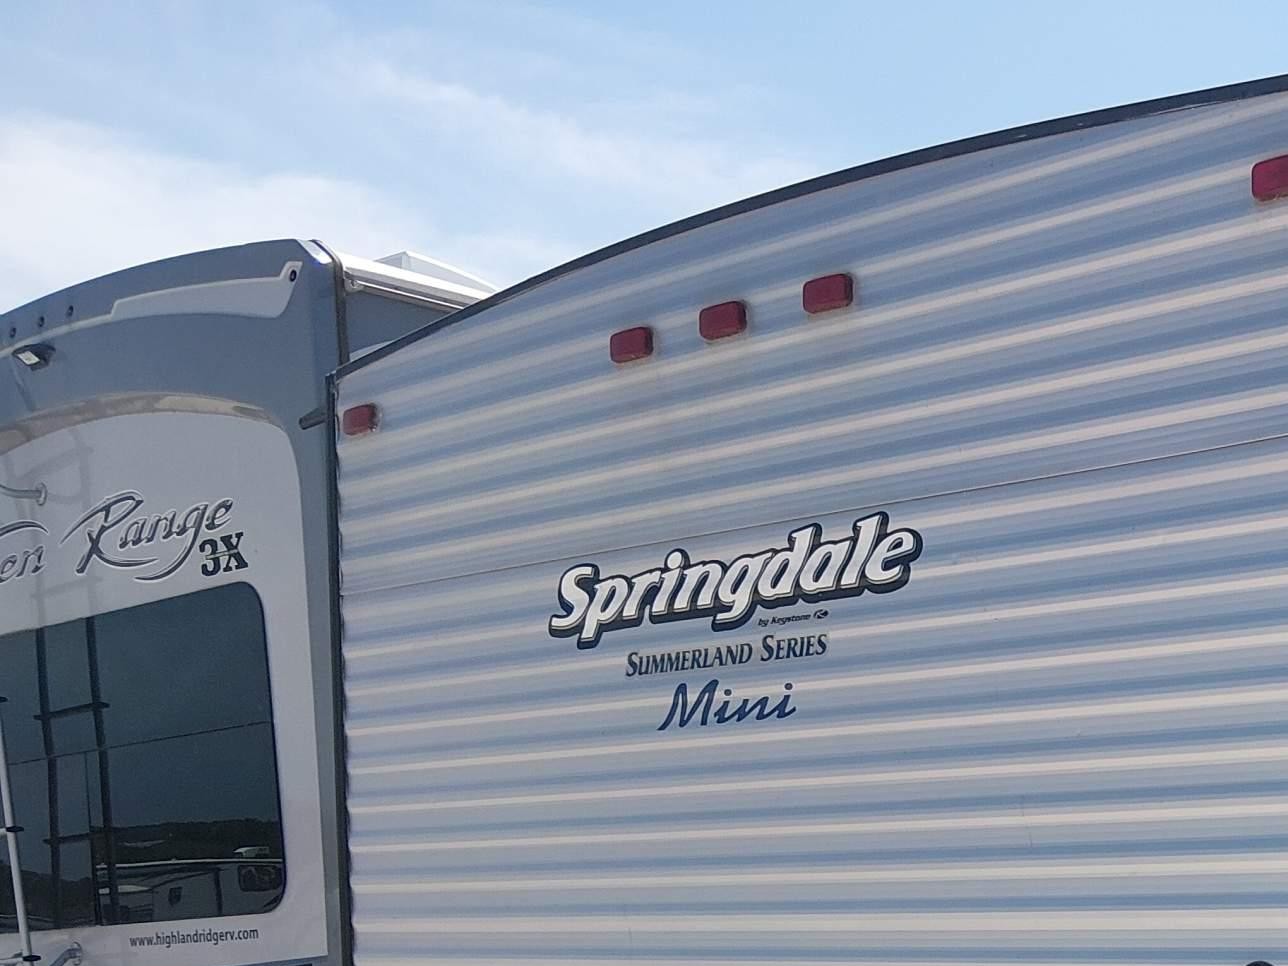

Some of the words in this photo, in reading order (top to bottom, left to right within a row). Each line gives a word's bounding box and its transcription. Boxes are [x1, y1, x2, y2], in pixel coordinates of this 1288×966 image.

[60, 489, 234, 581] Range
[199, 531, 249, 577] 3X
[548, 511, 923, 650] Springdale
[625, 643, 753, 677] SUMMERLAND
[760, 634, 828, 662] SERIES
[656, 679, 797, 731] Mini
[129, 928, 259, 949] www.highlandridgerv.com
